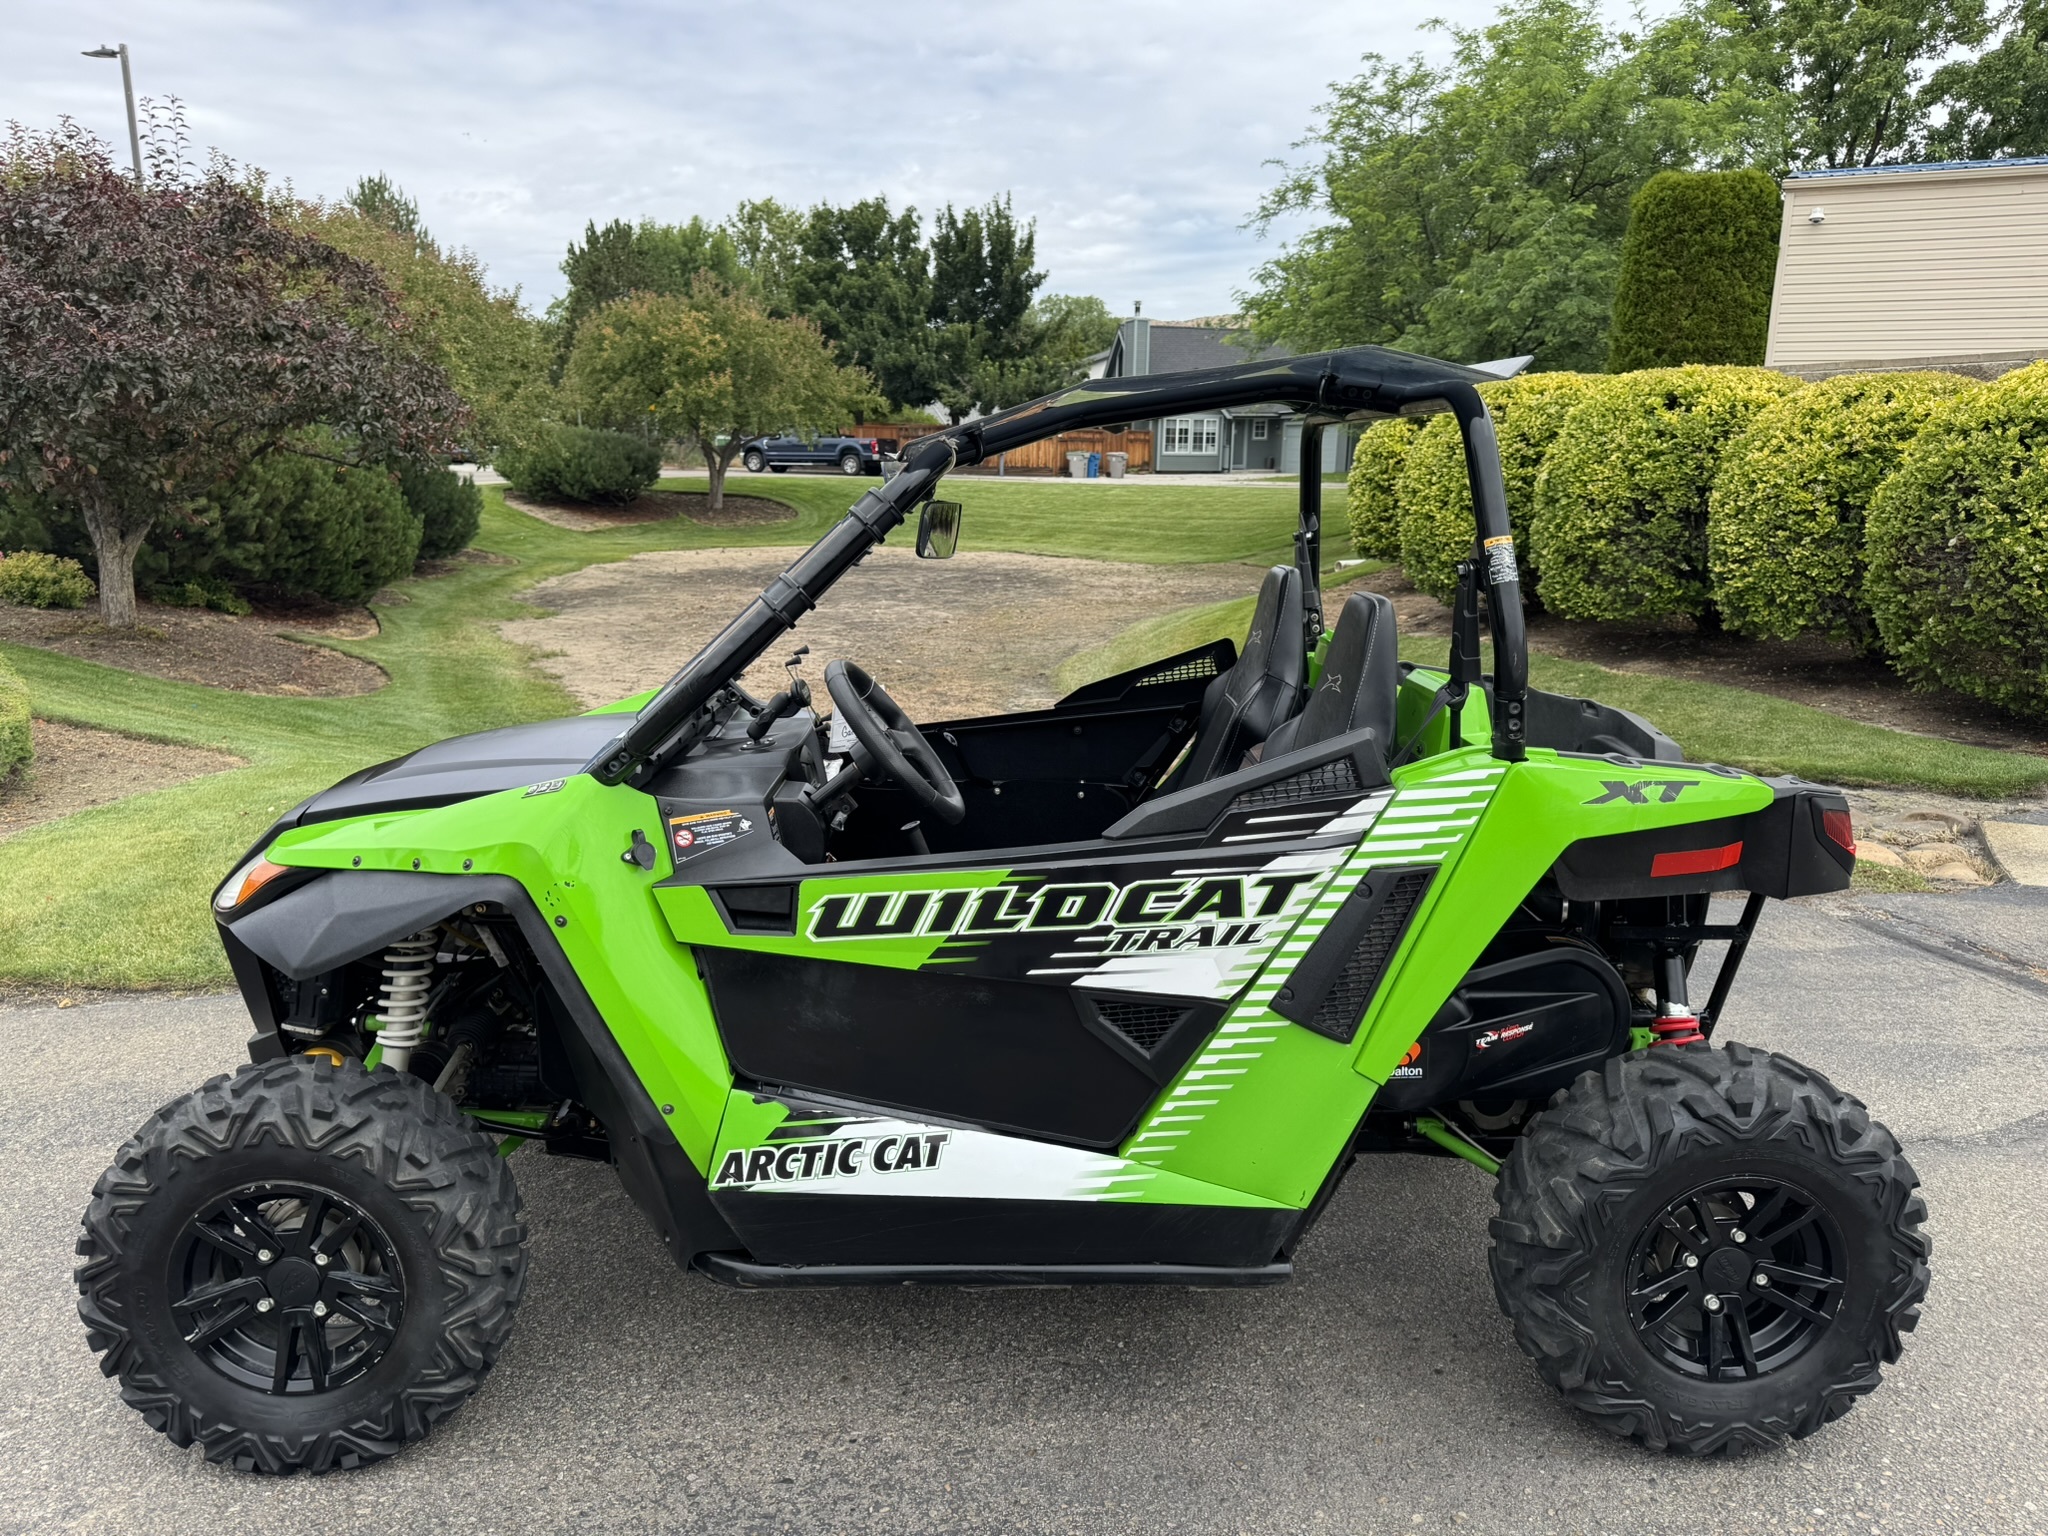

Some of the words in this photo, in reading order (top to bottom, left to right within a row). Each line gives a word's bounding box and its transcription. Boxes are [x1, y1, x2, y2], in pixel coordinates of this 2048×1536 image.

[1580, 780, 1701, 804] XT
[808, 872, 1321, 940] WILDCAT
[1107, 922, 1268, 954] TRAIL
[1475, 1033, 1499, 1045] TEAM
[1500, 1024, 1533, 1039] RESPONSE
[713, 1139, 867, 1186] ARCTIC
[871, 1131, 951, 1173] CAT
